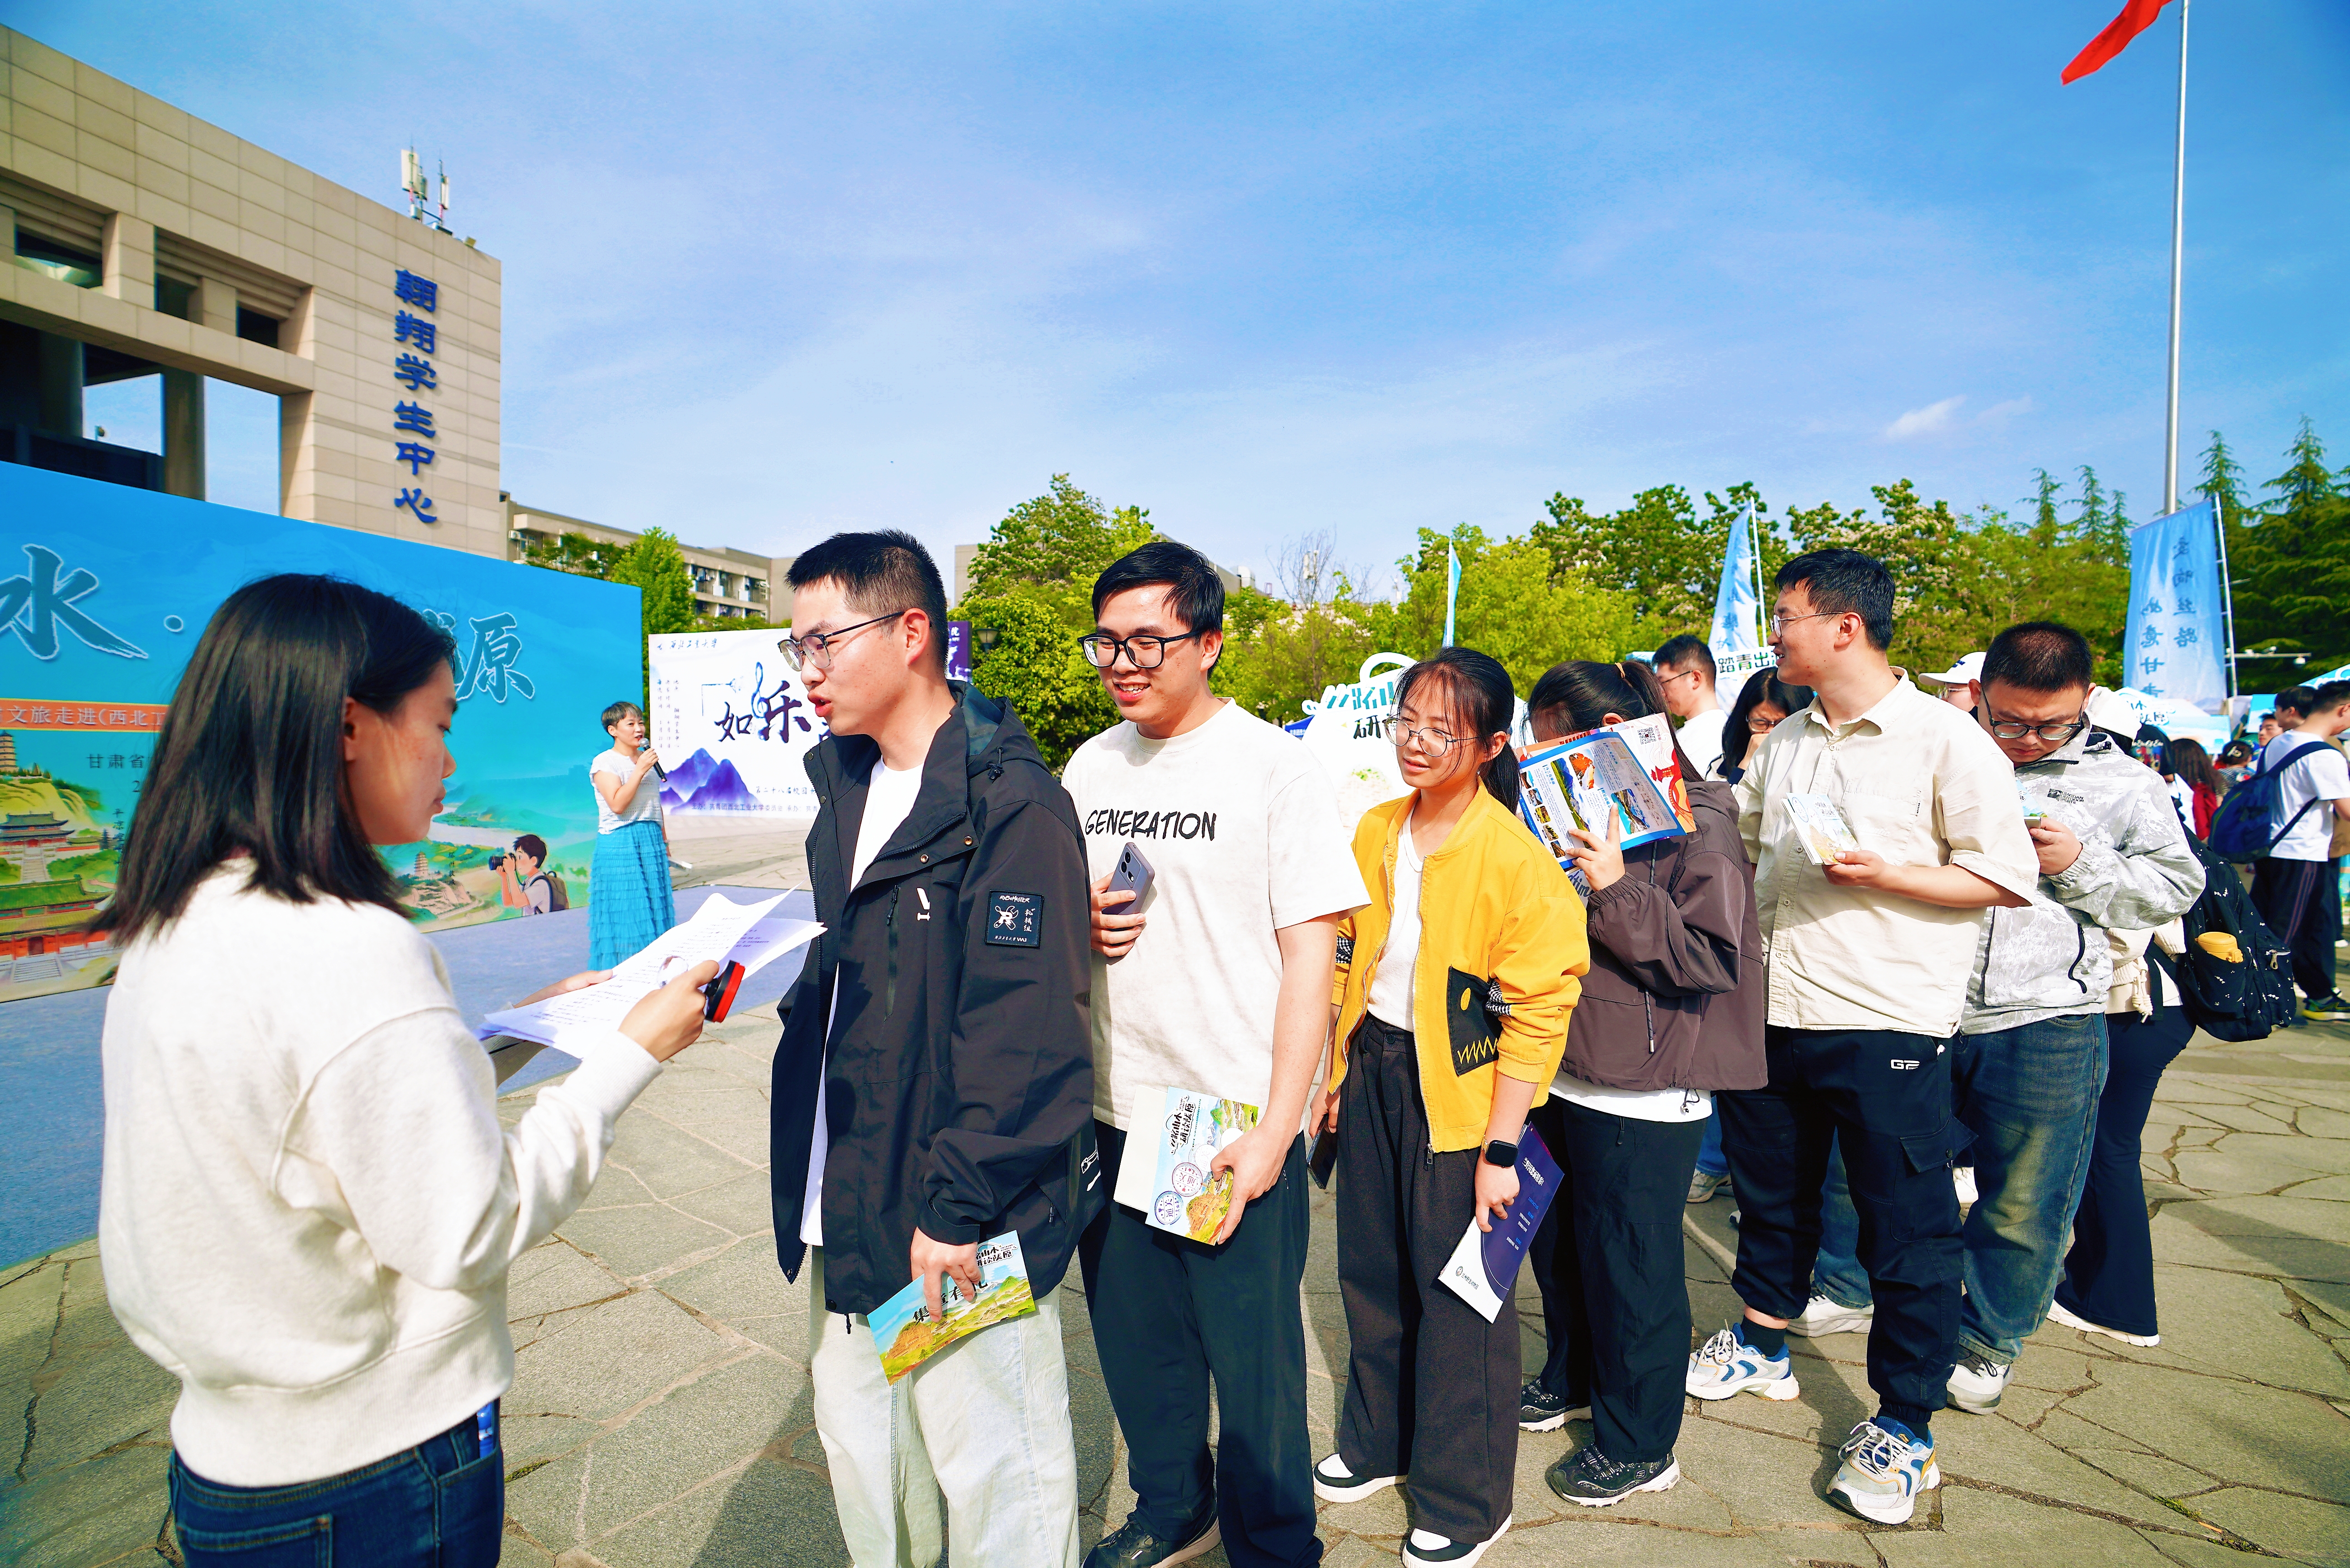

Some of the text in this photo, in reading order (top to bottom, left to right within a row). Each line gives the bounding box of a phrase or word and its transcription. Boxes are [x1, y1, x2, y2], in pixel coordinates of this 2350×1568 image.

[394, 270, 437, 523] 翱翔学生中心
[0, 705, 166, 726] 文旅走进(西北工
[2062, 791, 2084, 799] QIAODAN
[1085, 809, 1217, 841] GENERATION
